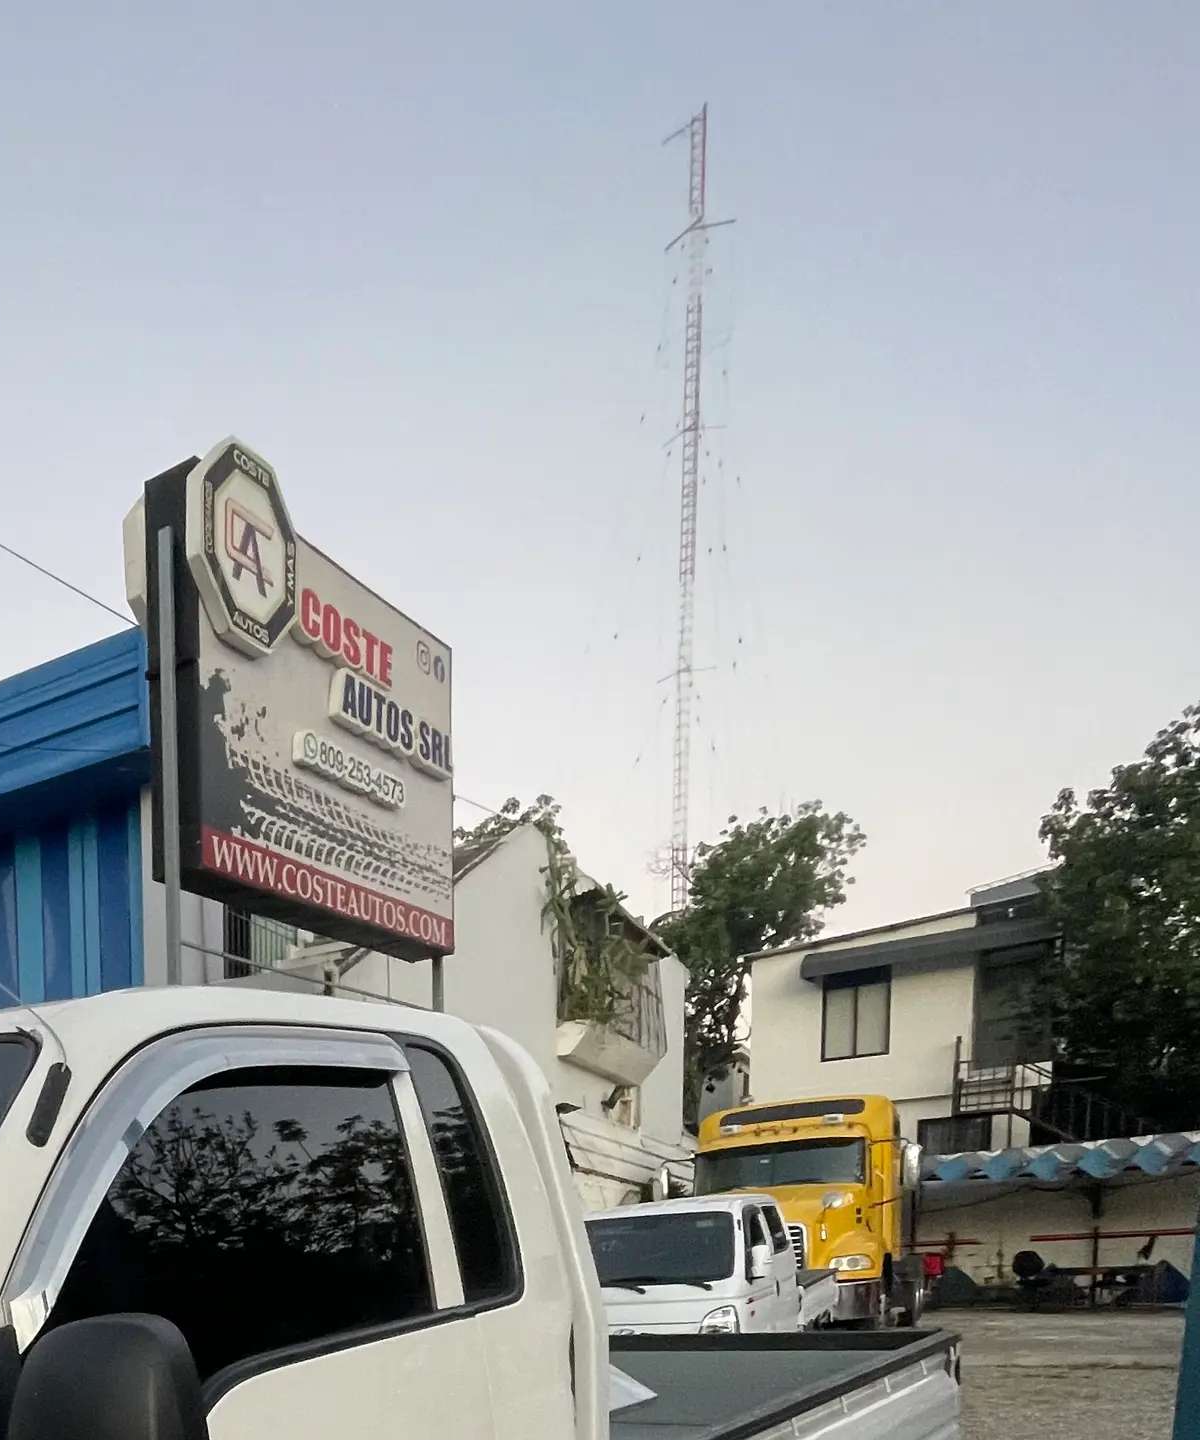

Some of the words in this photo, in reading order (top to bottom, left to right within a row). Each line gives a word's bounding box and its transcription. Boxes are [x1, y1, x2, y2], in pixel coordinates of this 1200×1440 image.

[232, 449, 270, 488] COSTE
[233, 611, 270, 645] AUTOS
[301, 587, 393, 688] COSTE
[342, 673, 414, 751] AUTOS
[419, 720, 452, 772] SRL
[211, 835, 447, 947] WWW.COSTEAUTOS.COM
